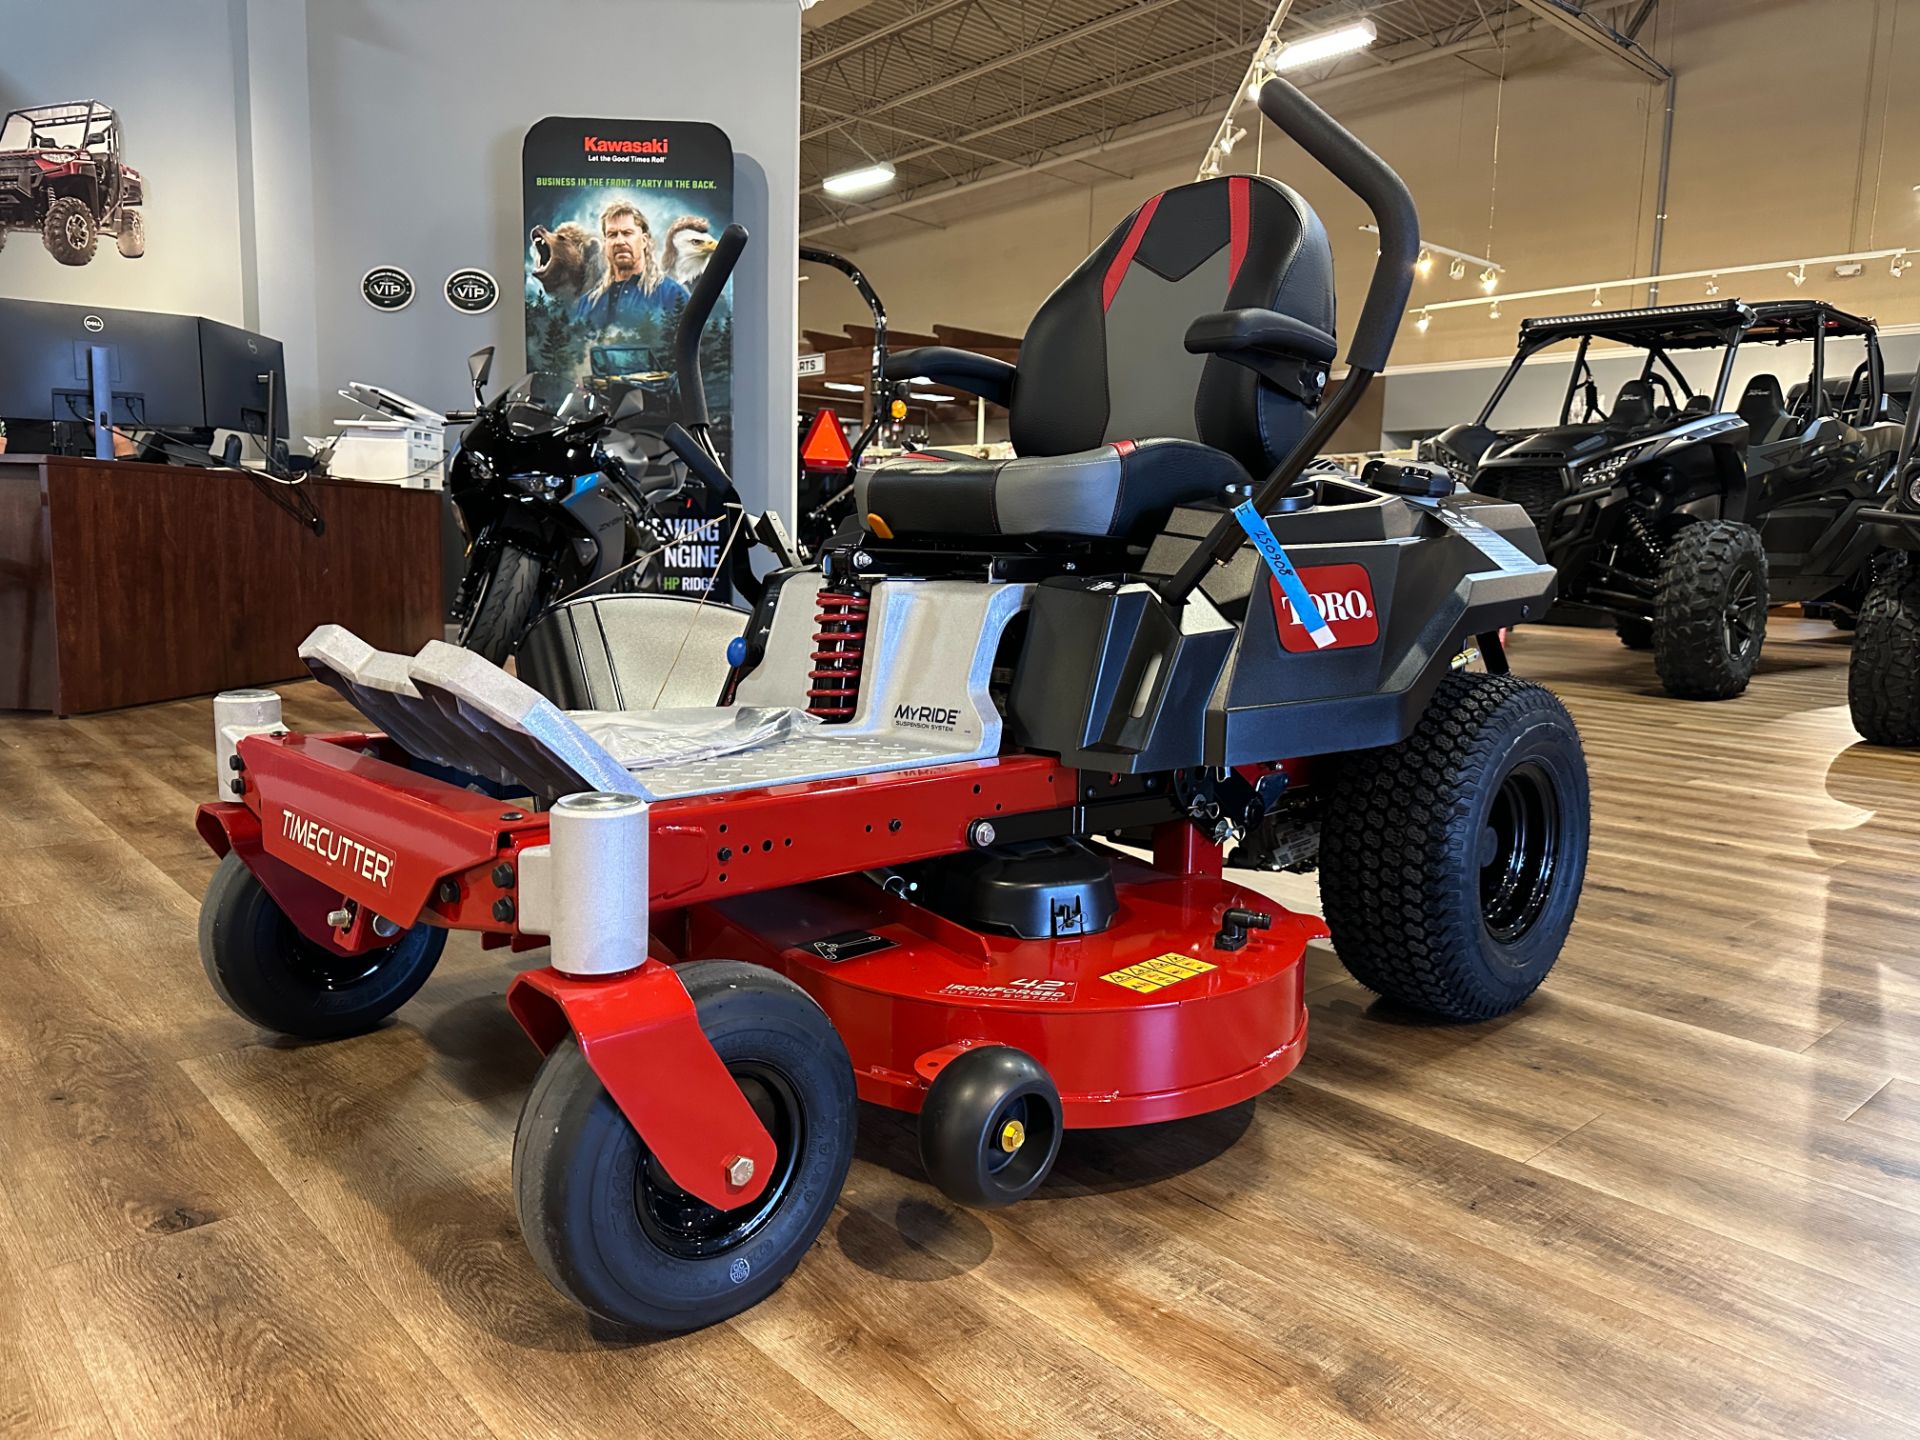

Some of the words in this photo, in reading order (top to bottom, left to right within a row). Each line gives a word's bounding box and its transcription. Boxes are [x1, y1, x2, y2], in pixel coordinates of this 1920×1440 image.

[584, 137, 669, 153] Kawasaki
[612, 155, 630, 163] Good
[536, 177, 576, 187] BUSINESS
[578, 178, 587, 187] IN
[589, 178, 604, 187] THE
[606, 178, 634, 188] FRONT.
[636, 179, 662, 188] PARTY
[664, 180, 673, 189] IN
[675, 180, 690, 189] THE
[692, 180, 717, 189] BACK.
[373, 284, 401, 295] VIP
[457, 287, 485, 298] VIP
[798, 360, 816, 371] RTS
[663, 545, 721, 568] NGINE
[663, 576, 680, 591] HP
[682, 577, 716, 591] RIDGE
[895, 720, 930, 729] SUSPENSION
[931, 724, 954, 732] SYSTEM
[282, 809, 394, 888] TIMECUTTER
[938, 990, 997, 998] CUTTING
[945, 983, 1066, 998] IRONFORGED
